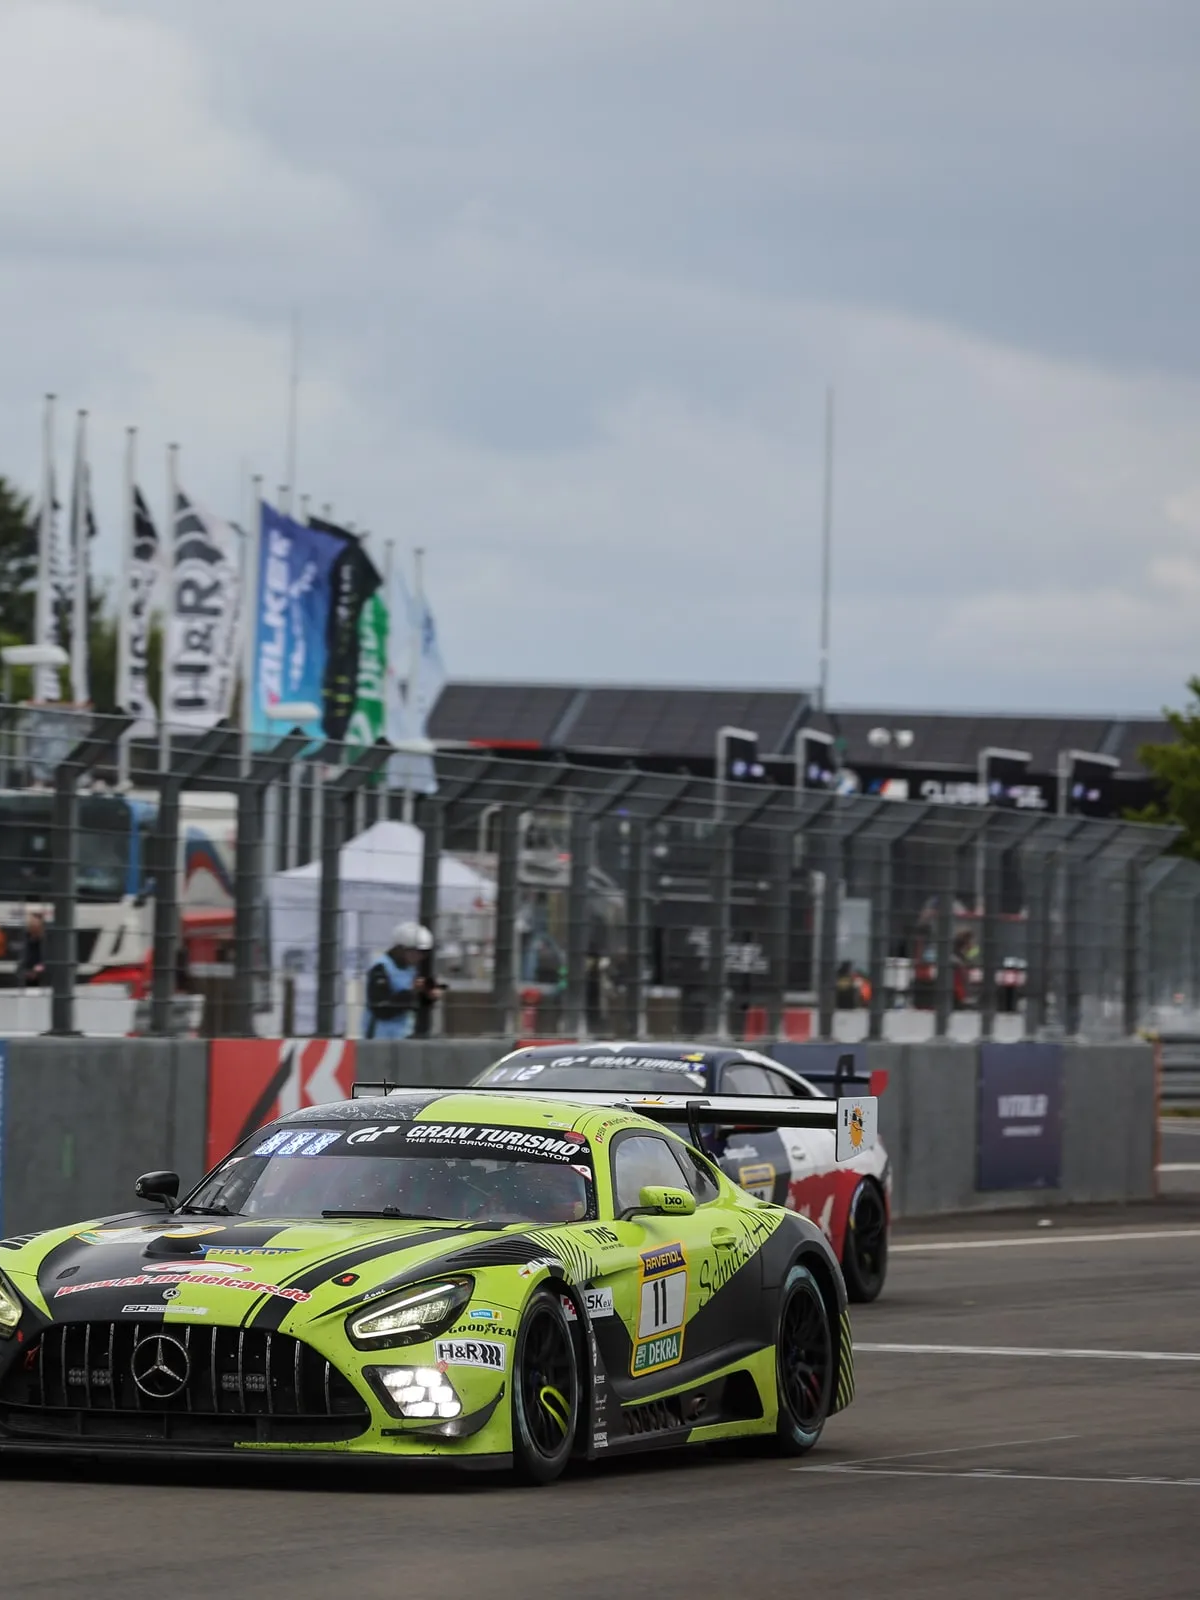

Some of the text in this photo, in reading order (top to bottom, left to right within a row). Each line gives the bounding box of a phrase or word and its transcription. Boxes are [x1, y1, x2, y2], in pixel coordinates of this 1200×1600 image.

[406, 1125, 475, 1139] GRAN
[476, 1129, 581, 1156] TURISMO
[459, 1140, 504, 1149] DRIVING
[506, 1145, 570, 1162] SIMULATOR
[584, 1226, 619, 1245] TMS
[645, 1251, 682, 1271] RAVENOL
[54, 1274, 314, 1303] www.ck-modelcars.de
[585, 1294, 603, 1309] SK
[652, 1279, 668, 1328] 11
[649, 1335, 678, 1365] DEKRA
